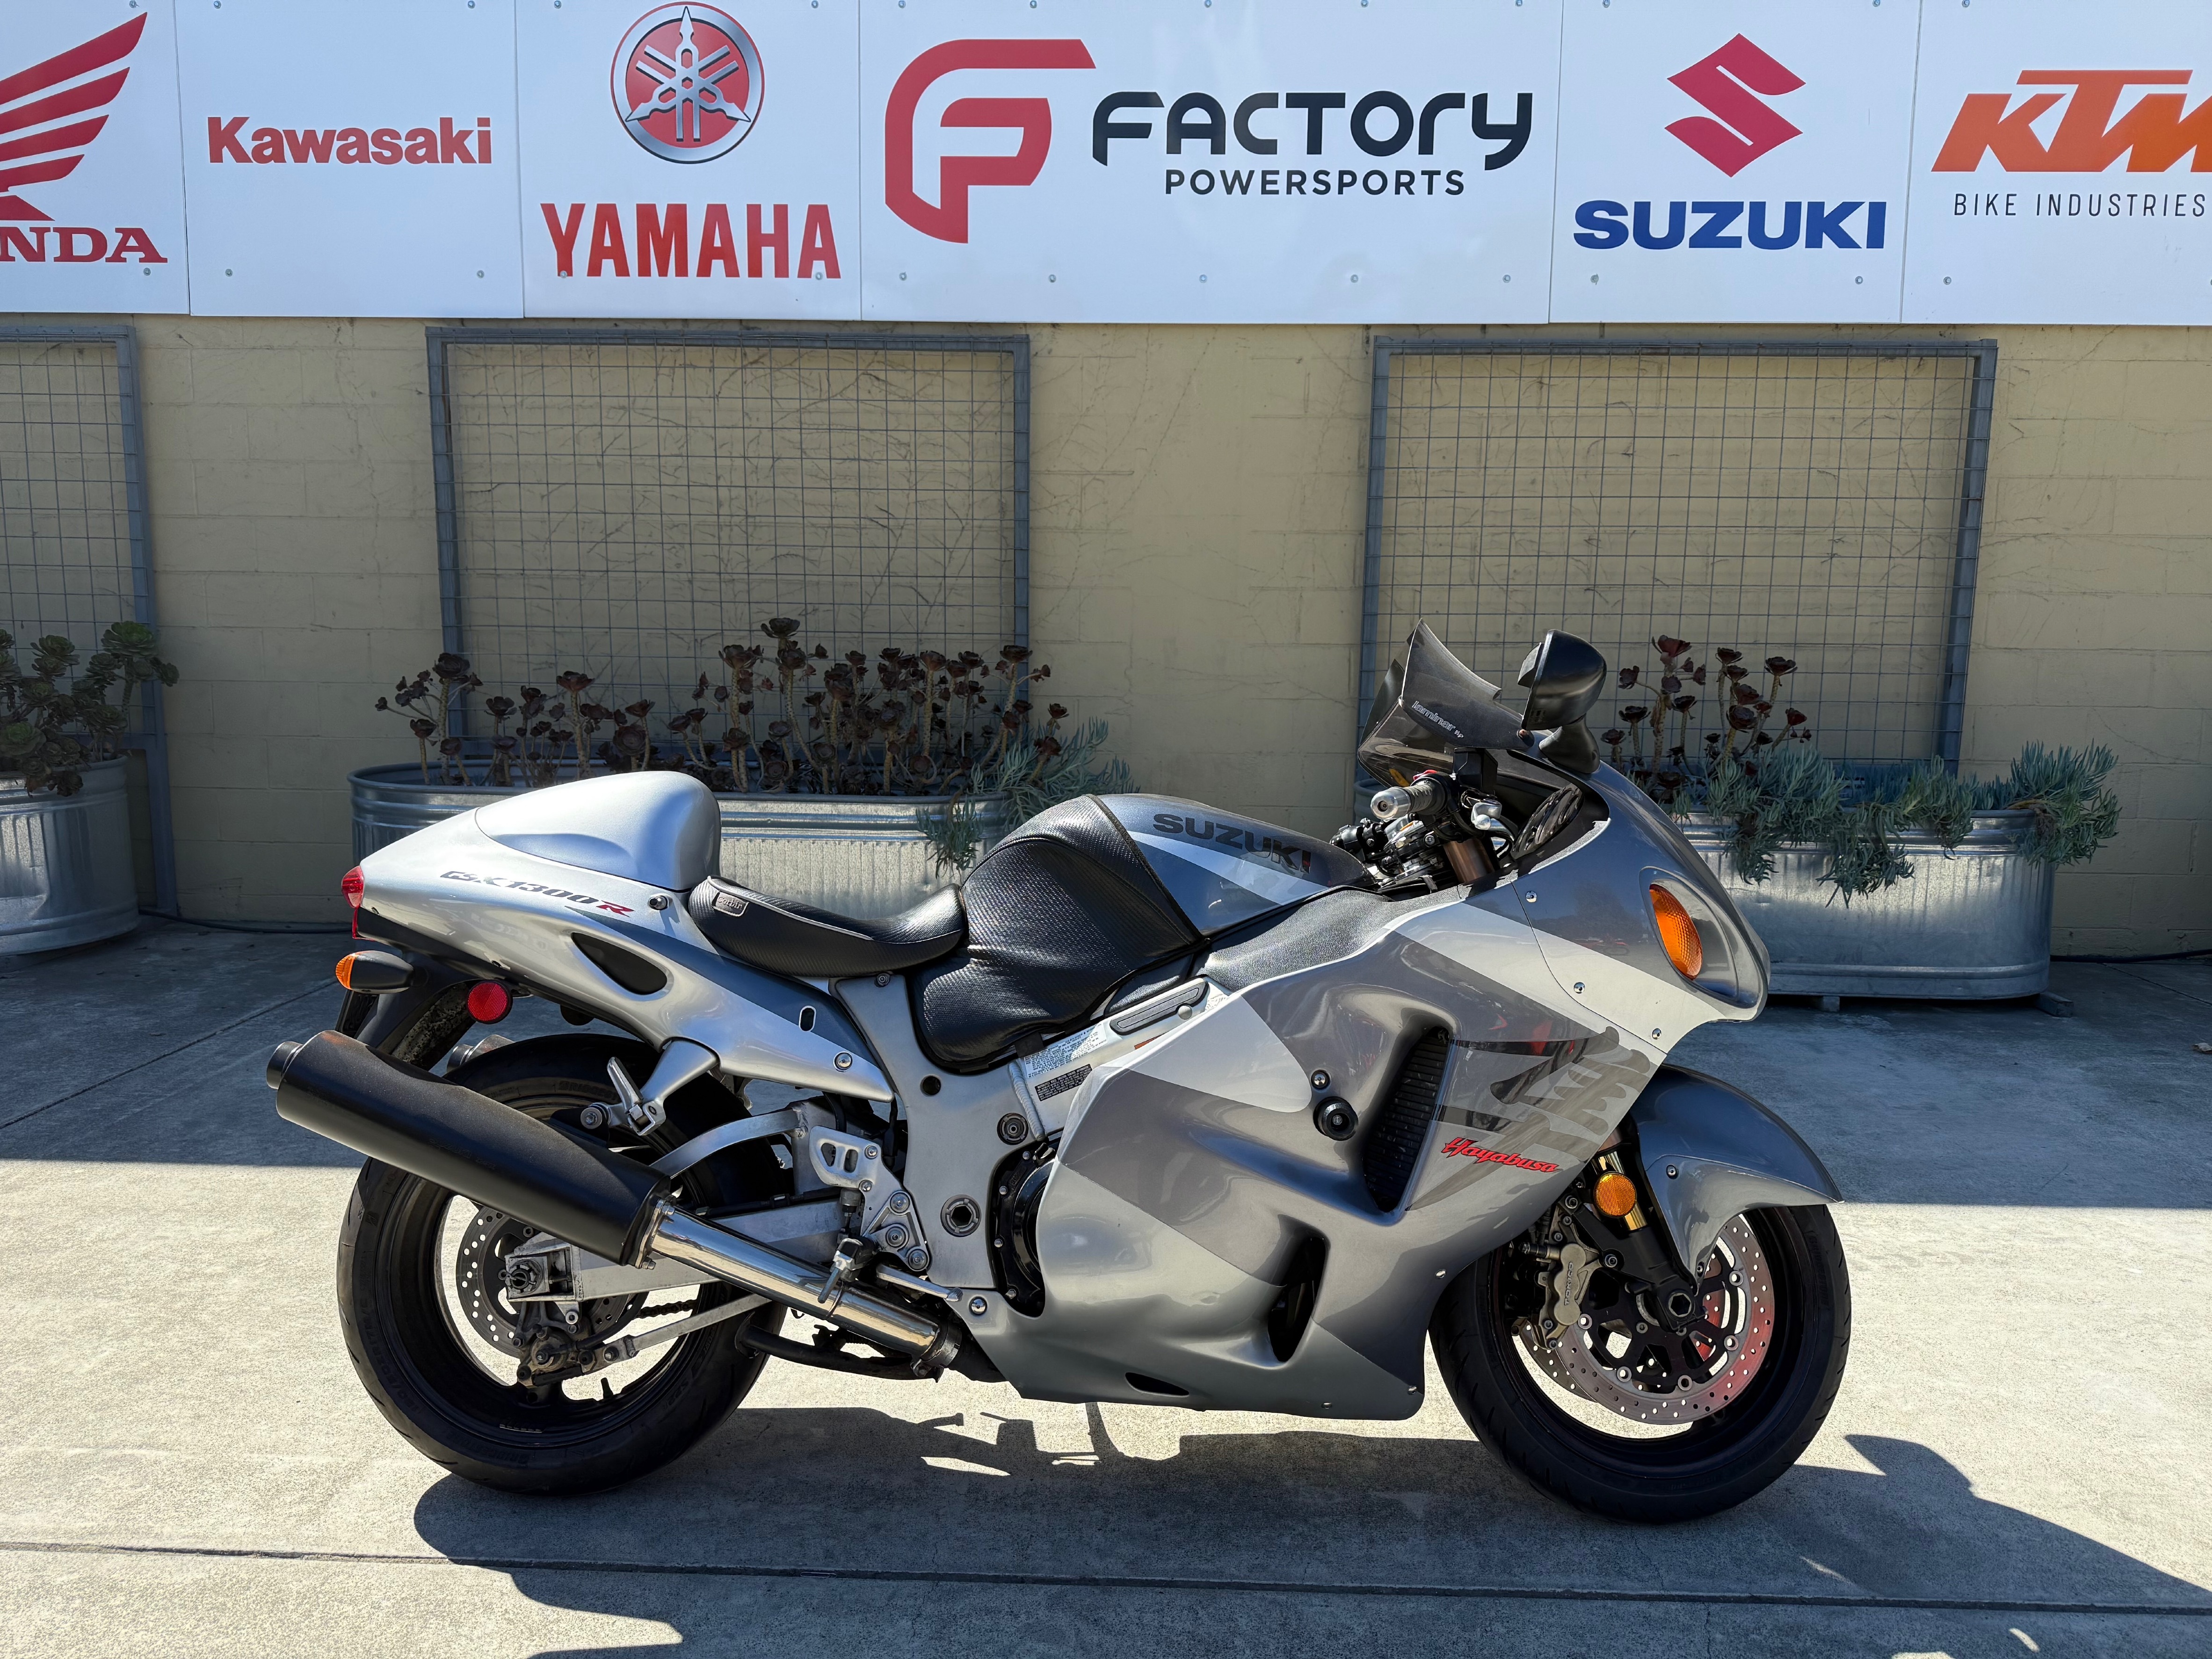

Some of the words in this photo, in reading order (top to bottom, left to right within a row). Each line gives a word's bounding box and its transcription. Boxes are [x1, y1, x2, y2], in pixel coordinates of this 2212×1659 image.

[208, 116, 492, 165] Kawasaki
[1165, 169, 1465, 196] POWERSPORTS
[1573, 200, 1887, 250] SUZUKI
[1954, 193, 2018, 216] BIKE
[2036, 193, 2205, 217] INDUSTRIES
[0, 227, 167, 263] NDA
[540, 203, 841, 279] YAMAHA
[1412, 700, 1456, 731] laminar
[1153, 813, 1312, 874] SUZUKI
[440, 871, 635, 917] GSX1300R
[718, 896, 742, 910] Corbin
[1441, 1137, 1560, 1172] Hayabusa
[1564, 1261, 1573, 1306] TOKICO
